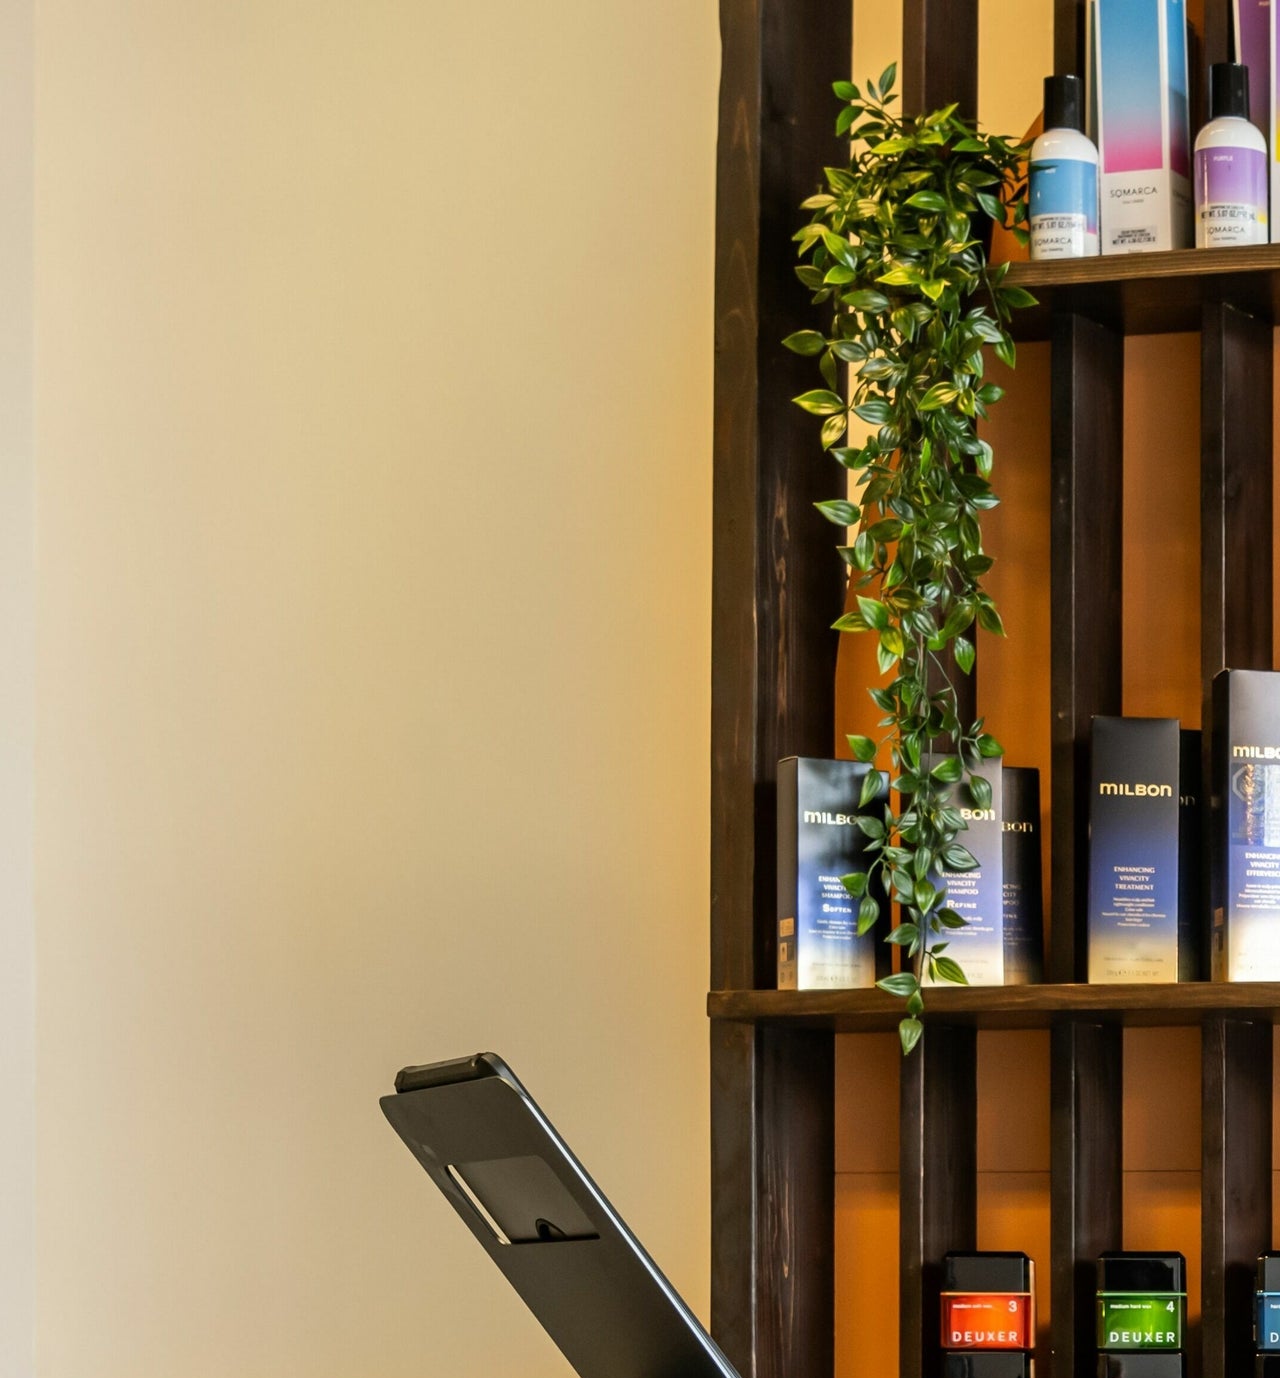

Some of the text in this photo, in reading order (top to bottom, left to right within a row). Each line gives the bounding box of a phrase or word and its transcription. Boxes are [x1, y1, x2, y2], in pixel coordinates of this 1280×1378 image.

[1110, 187, 1157, 198] SOMARCA
[1100, 783, 1172, 797] MILBON
[804, 811, 858, 825] MILBO
[1114, 866, 1155, 874] ENHANCING
[823, 904, 852, 914] SOFTEN
[947, 900, 976, 909] REFINE
[1009, 1302, 1017, 1312] 3
[1166, 1302, 1174, 1312] 4
[953, 1332, 1017, 1342] DEUXER
[1110, 1332, 1174, 1342] DEUXER
